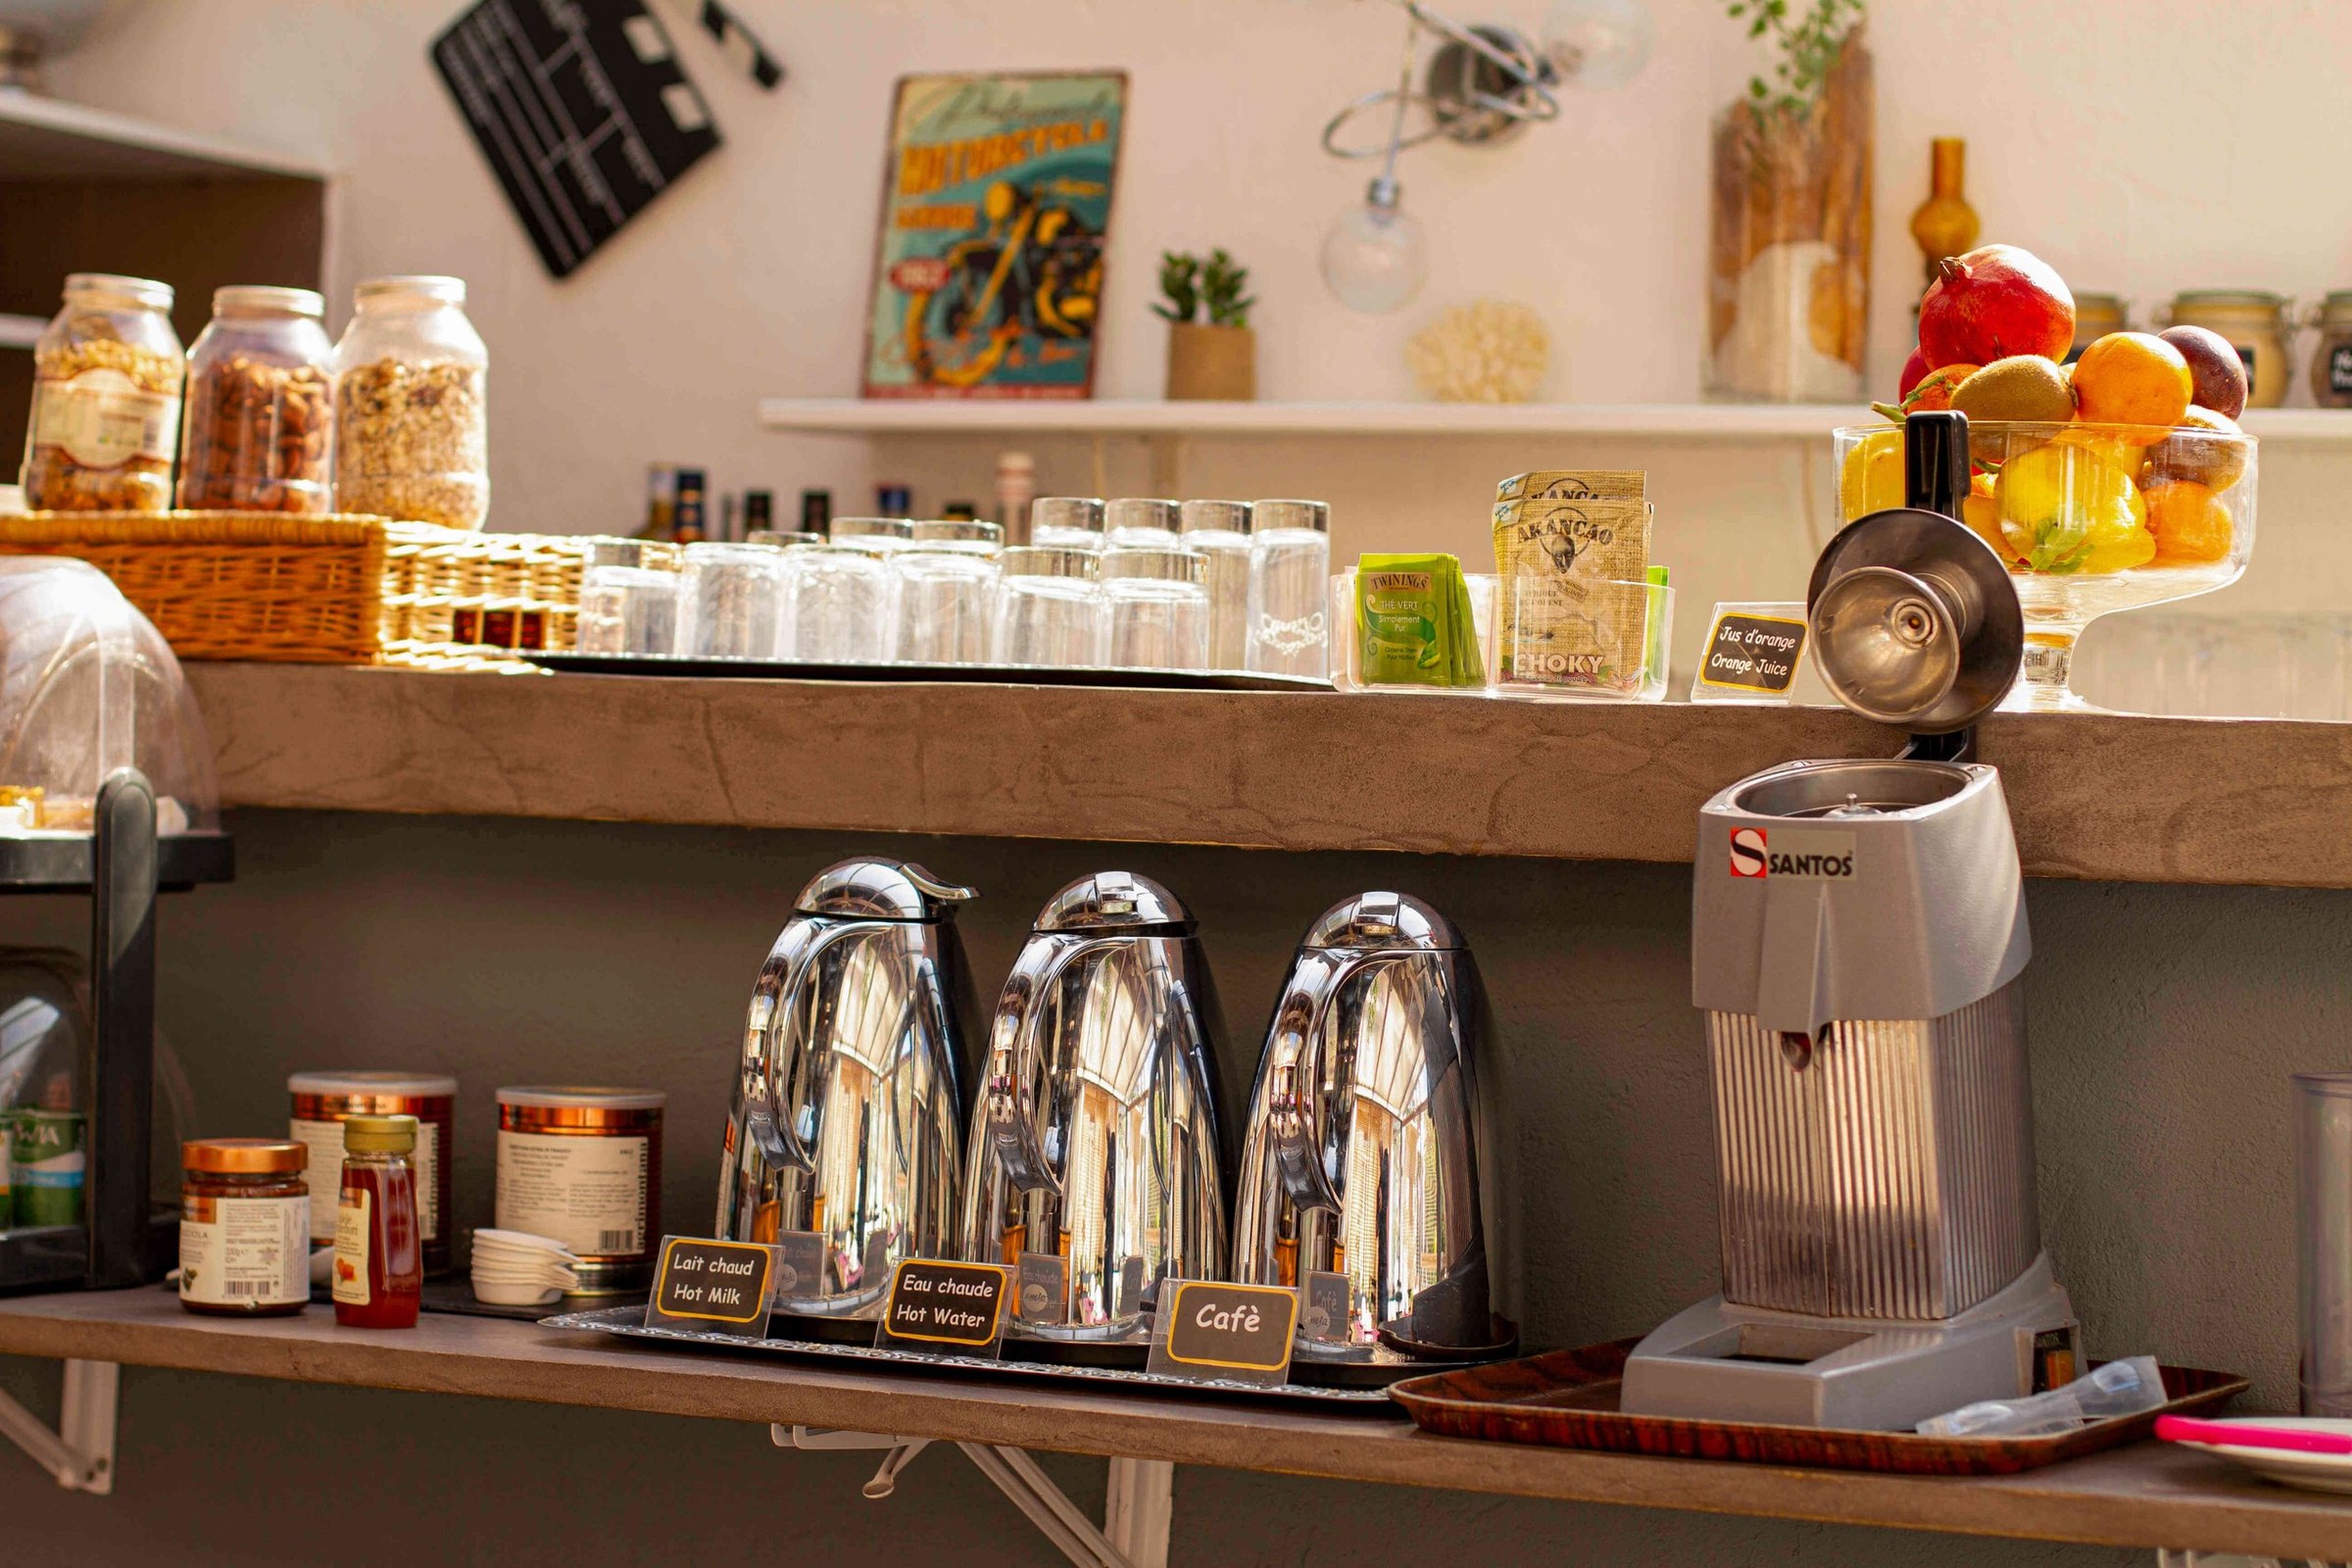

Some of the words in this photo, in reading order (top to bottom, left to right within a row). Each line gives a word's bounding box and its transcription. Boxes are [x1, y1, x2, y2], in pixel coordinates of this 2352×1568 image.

[1370, 573, 1429, 590] TWININGS
[1380, 599, 1396, 610] THÉ
[1397, 601, 1419, 612] VERT
[1379, 614, 1420, 624] Simplement
[1395, 623, 1406, 632] Pur
[1719, 626, 1742, 642] Jus
[1745, 628, 1795, 652] d'orange
[1517, 654, 1605, 674] CHOKY
[1711, 653, 1752, 674] Orange
[1755, 659, 1788, 676] Juice
[1769, 853, 1853, 877] SANTOS
[673, 1253, 705, 1272] Lait
[709, 1256, 755, 1276] chaud
[673, 1283, 704, 1301] Hot
[708, 1287, 741, 1305] Milk
[903, 1274, 933, 1293] Eau
[938, 1277, 994, 1298] chaude
[897, 1303, 928, 1323] Hot
[934, 1307, 986, 1328] Water
[1196, 1303, 1260, 1333] Cafè
